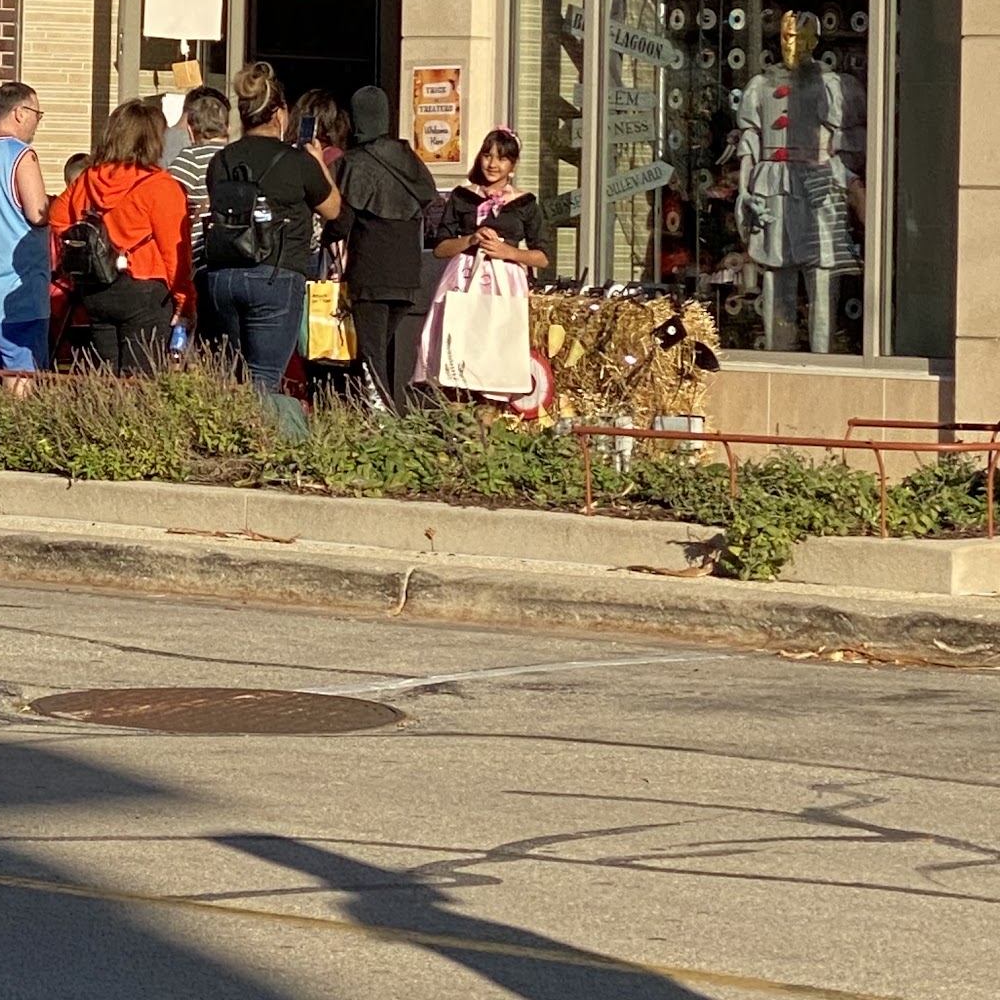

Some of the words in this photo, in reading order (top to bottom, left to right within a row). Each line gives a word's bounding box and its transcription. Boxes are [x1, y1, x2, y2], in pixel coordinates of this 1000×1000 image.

[615, 28, 663, 60] LAGOON
[614, 120, 649, 135] NESS
[606, 165, 663, 197] OULEVARD
